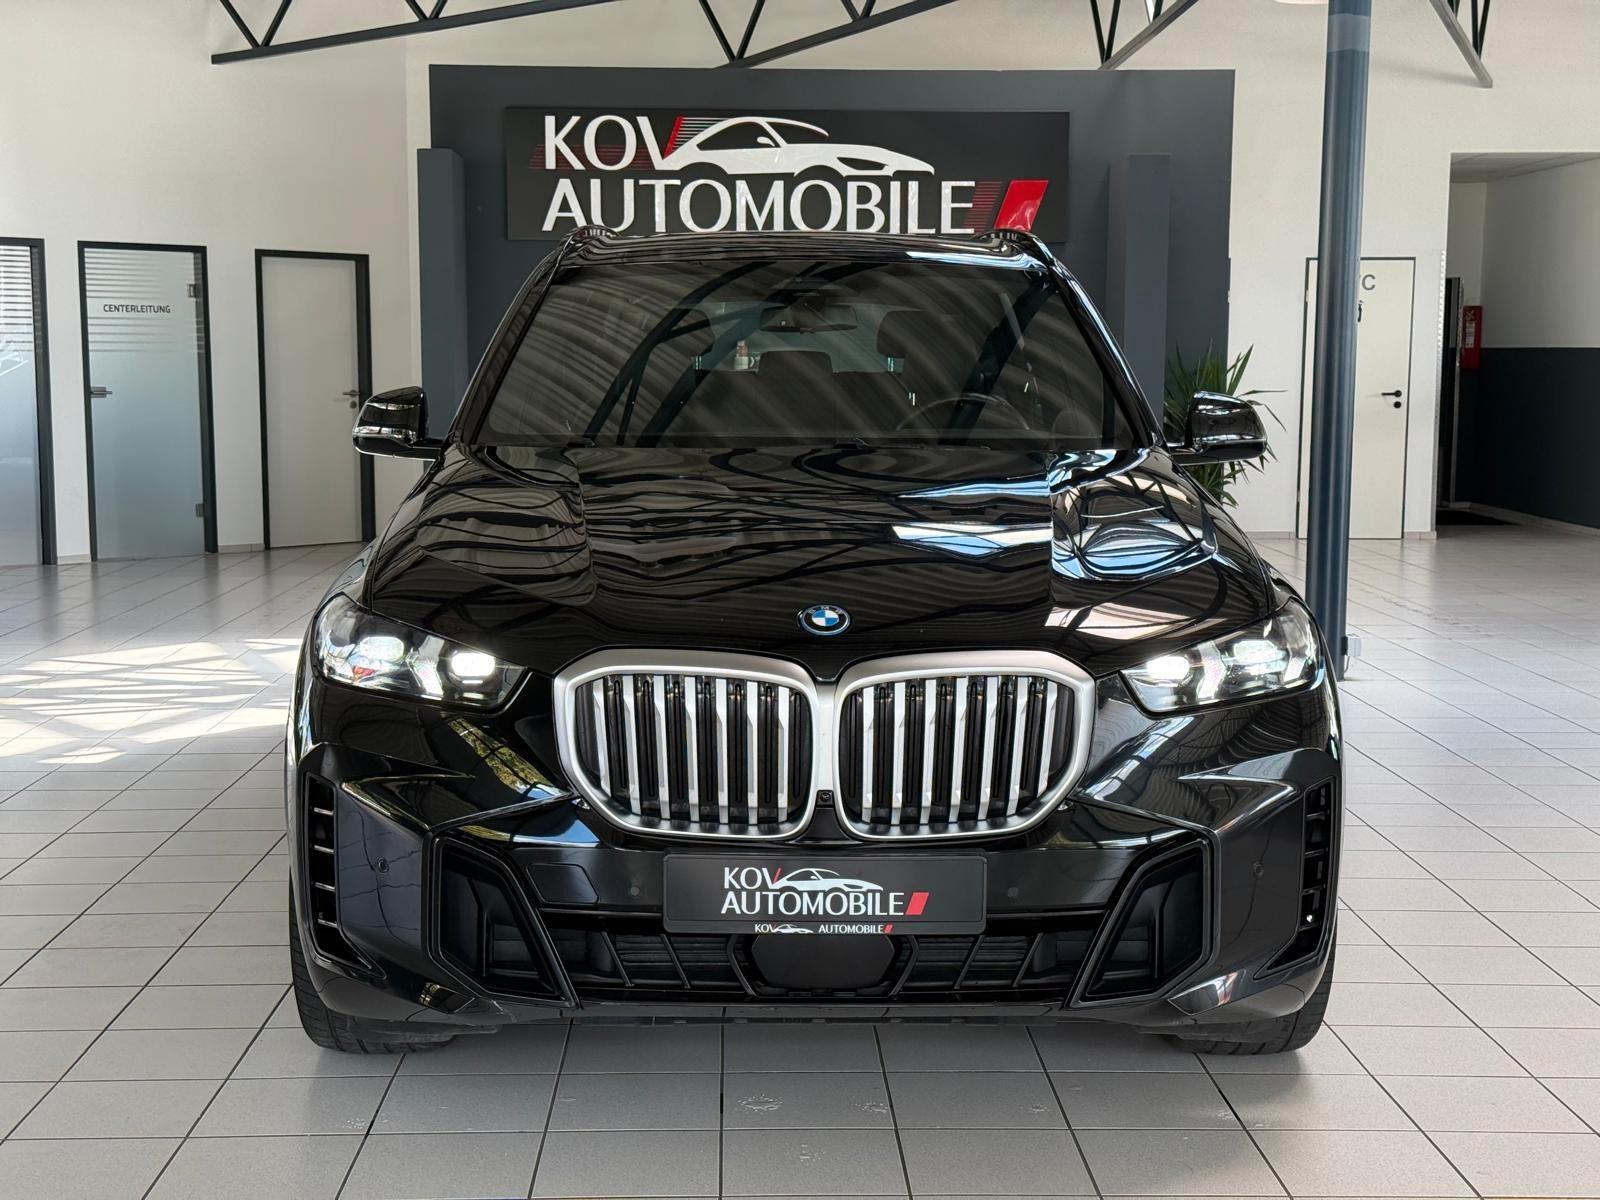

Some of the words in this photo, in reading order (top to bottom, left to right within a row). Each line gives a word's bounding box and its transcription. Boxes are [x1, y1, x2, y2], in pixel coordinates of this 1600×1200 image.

[544, 115, 684, 171] KOV
[541, 178, 976, 234] AUTOMOBILE
[103, 303, 172, 314] CENTERLEITUNG
[723, 866, 782, 890] KOV
[720, 890, 905, 916] AUTOMOBILE
[754, 923, 777, 934] KOV
[818, 923, 885, 934] AUTOMOBILE
